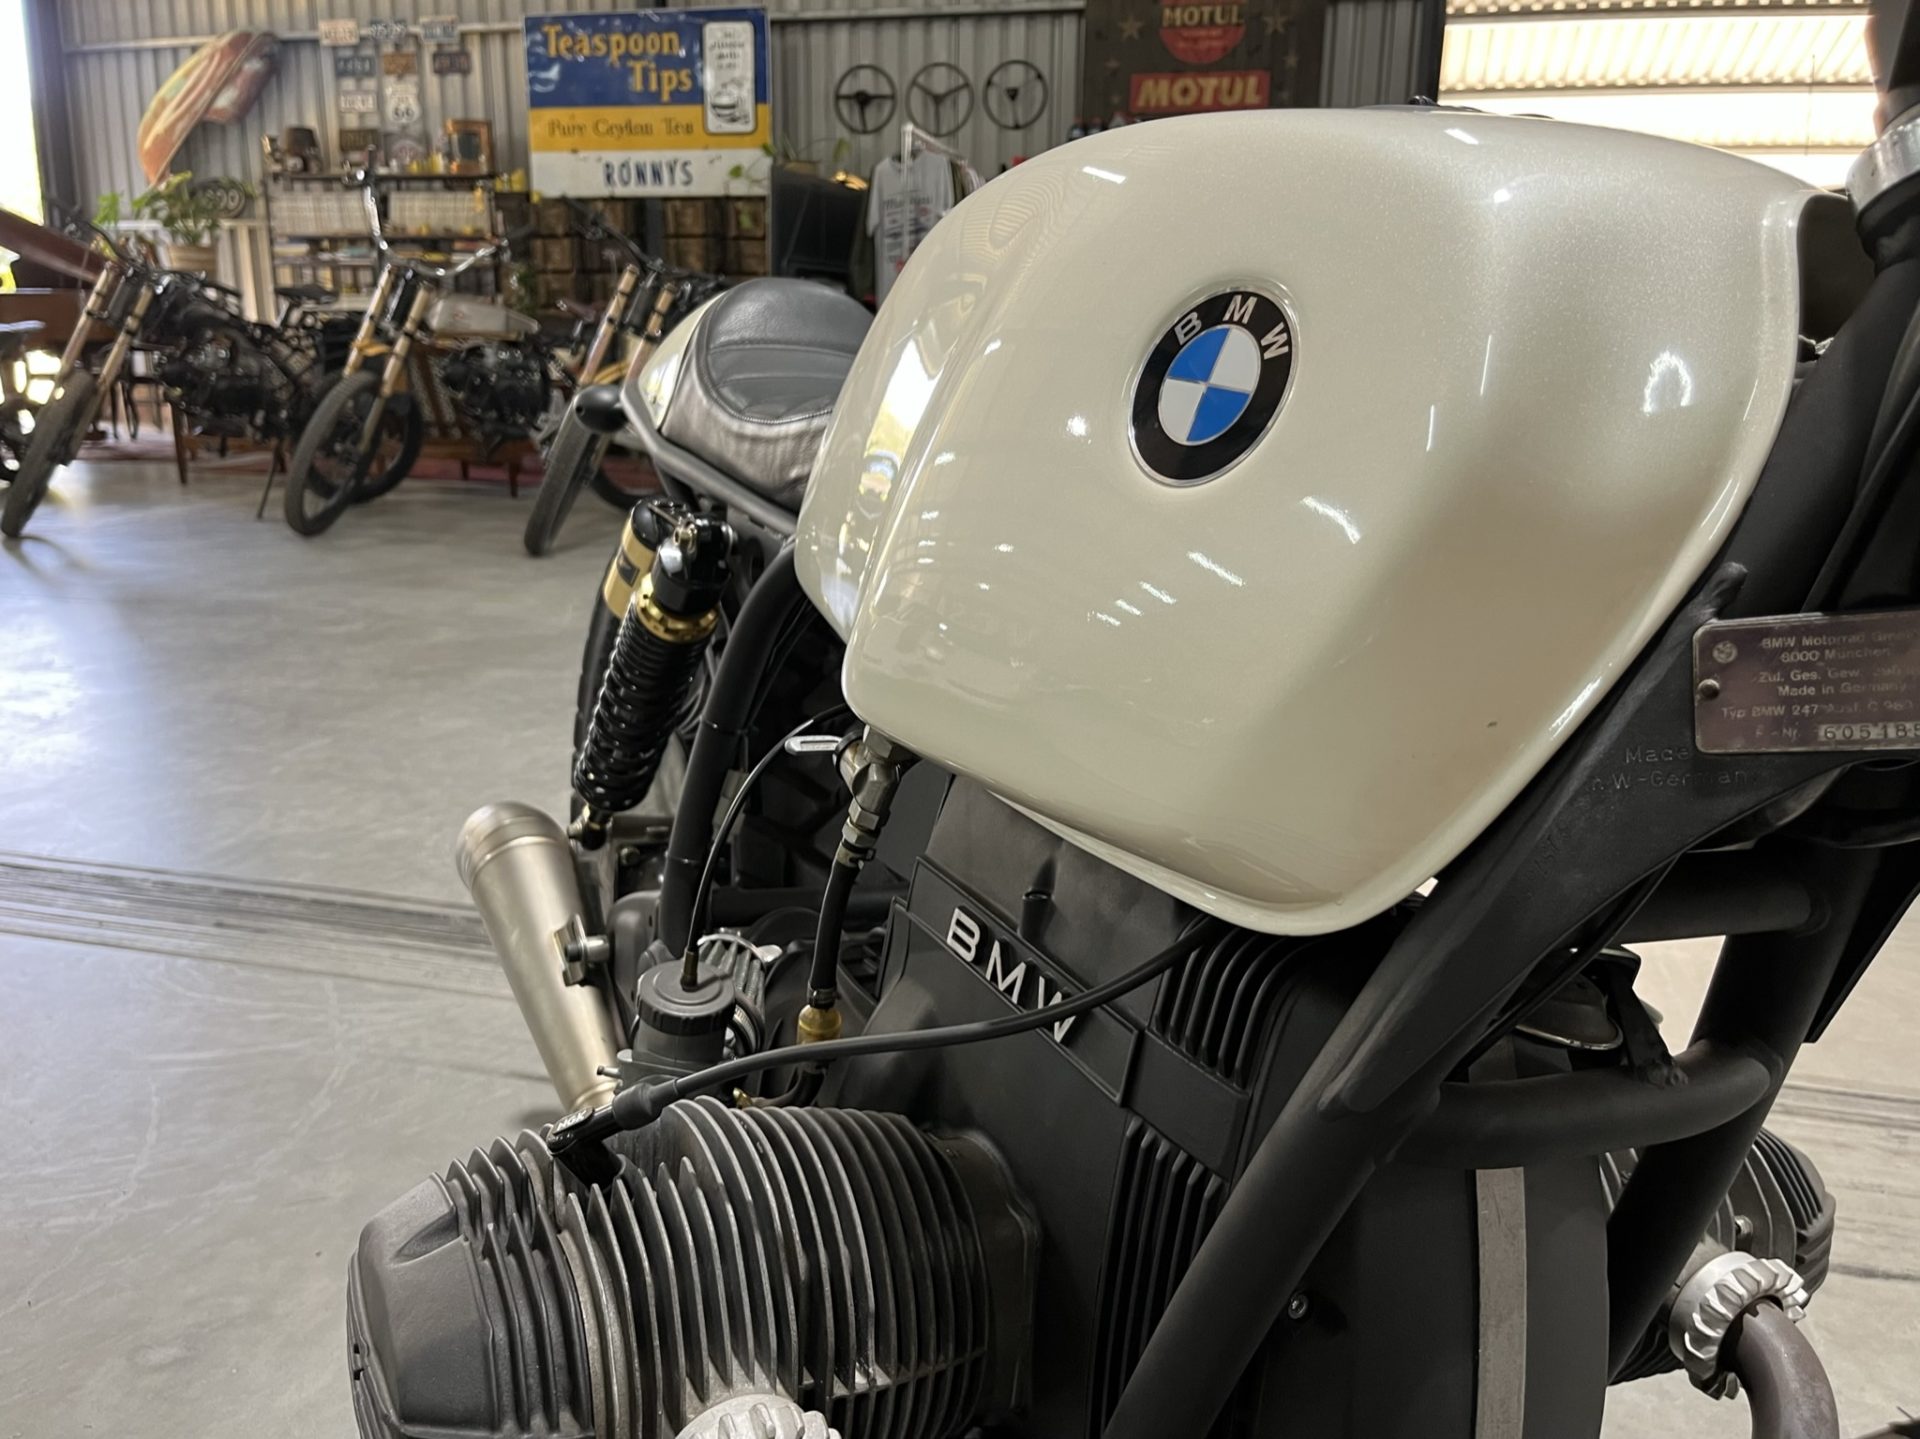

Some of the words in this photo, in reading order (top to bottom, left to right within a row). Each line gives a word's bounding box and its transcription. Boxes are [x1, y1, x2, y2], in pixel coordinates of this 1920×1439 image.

[1162, 5, 1244, 26] MOTUL
[542, 22, 681, 68] Teaspoon
[627, 60, 693, 102] Tips
[1138, 75, 1263, 107] MOTUL
[602, 158, 694, 188] RONNYS
[1173, 294, 1289, 360] BMW
[1761, 635, 1796, 649] BMW
[1790, 669, 1822, 681] Ges.
[1777, 685, 1816, 697] Made
[1822, 683, 1834, 695] in
[1721, 707, 1746, 719] Typ
[1751, 705, 1785, 717] BMW
[1792, 704, 1818, 717] 247
[946, 907, 1077, 1044] BMW
[557, 1110, 587, 1132] NGK
